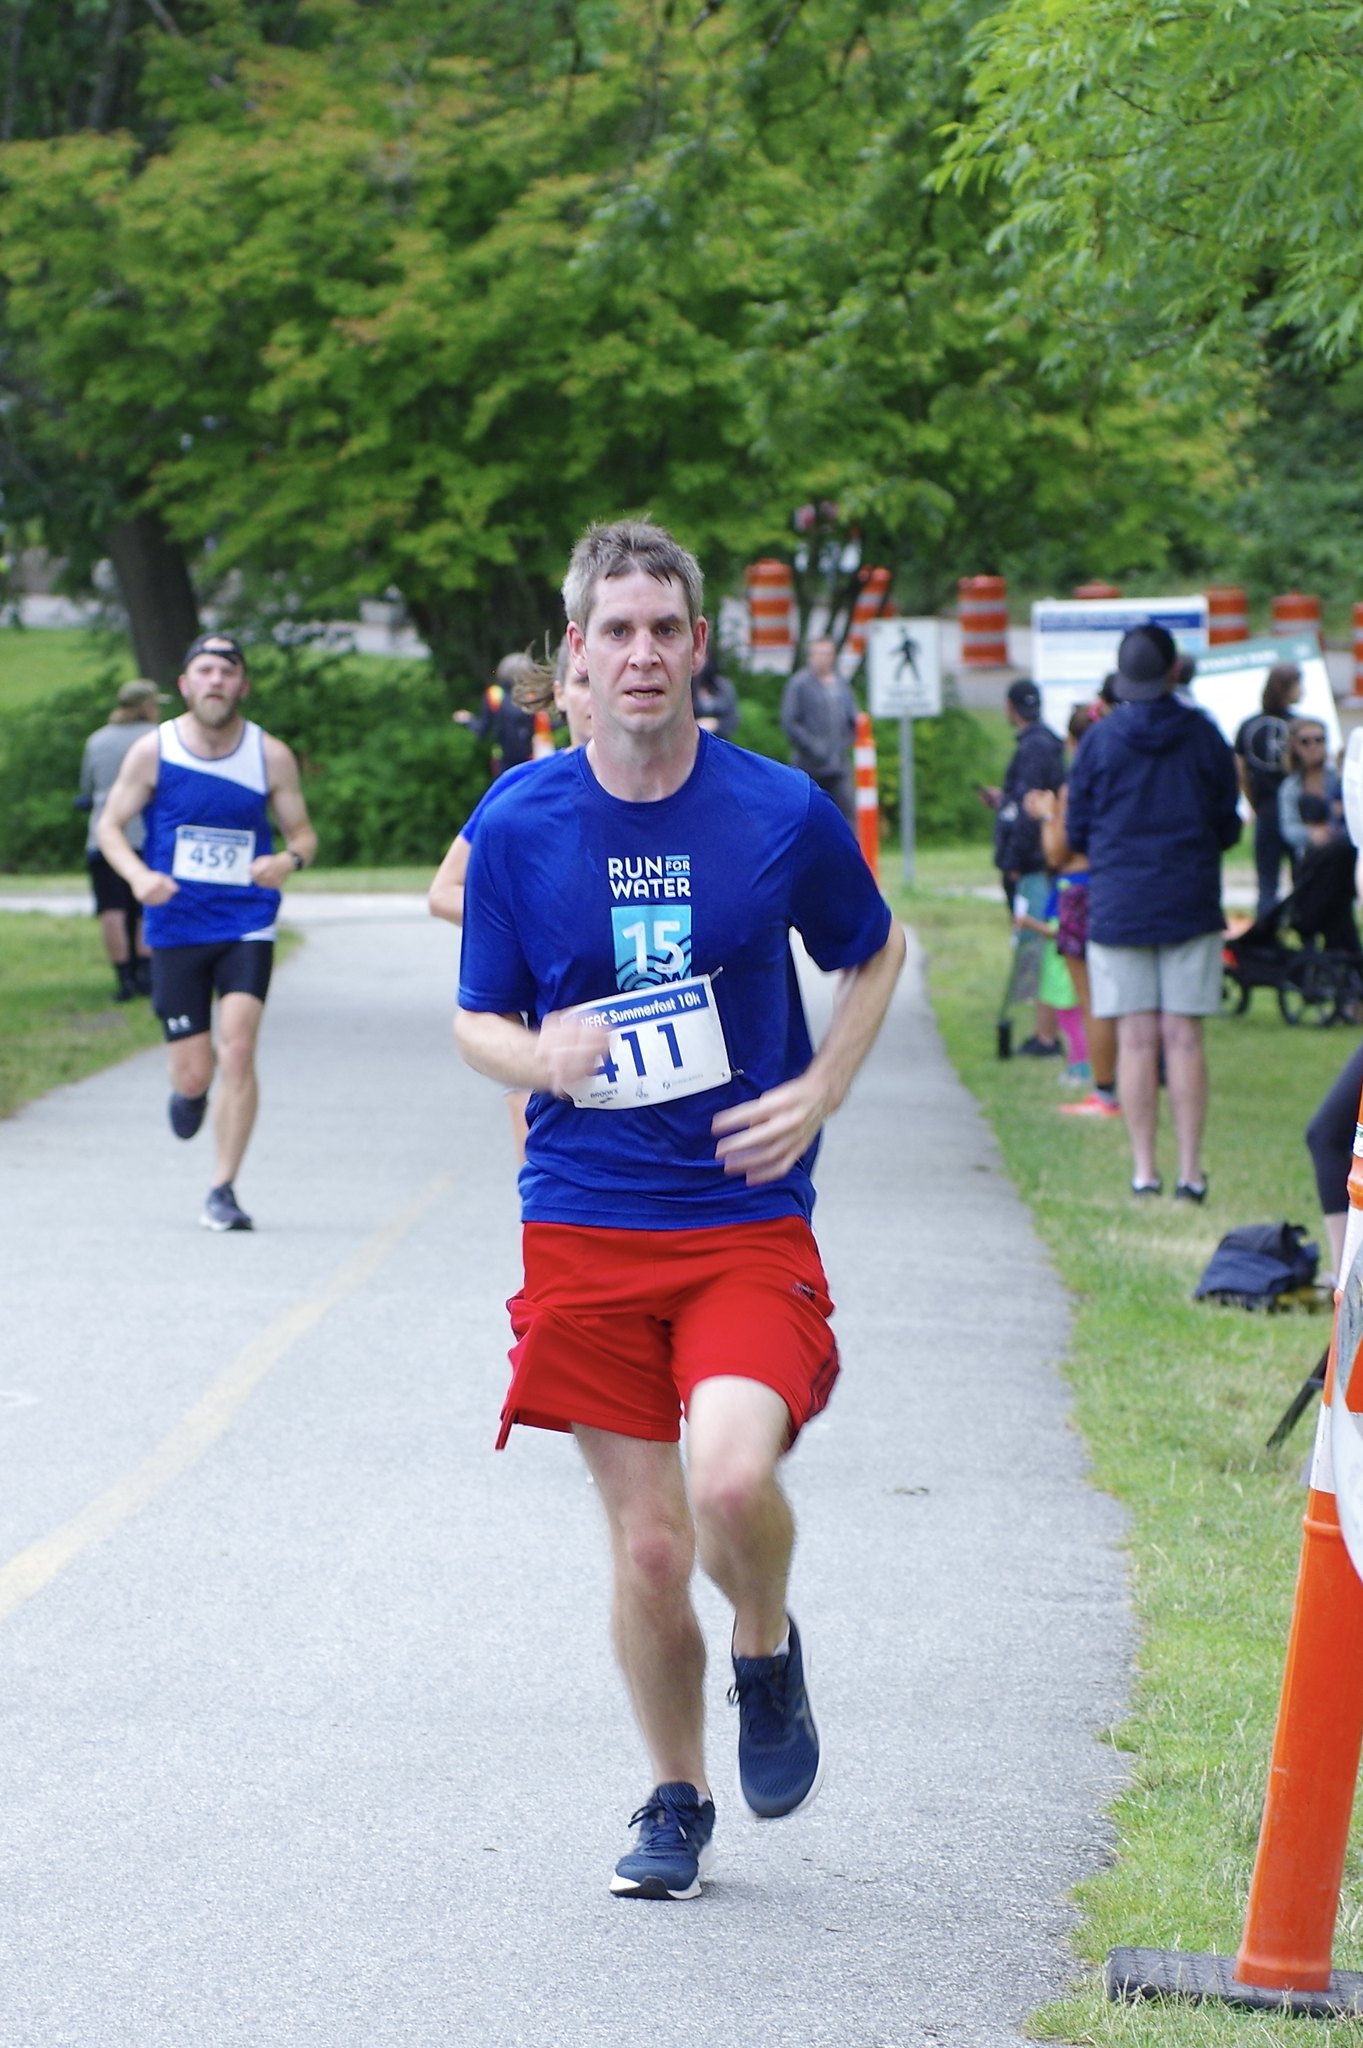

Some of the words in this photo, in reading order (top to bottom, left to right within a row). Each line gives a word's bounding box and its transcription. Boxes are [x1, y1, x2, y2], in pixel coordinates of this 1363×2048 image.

[190, 846, 237, 869] 459
[607, 855, 663, 879] RUN
[665, 860, 690, 872] FOR
[609, 877, 691, 900] WATER
[622, 920, 684, 974] 15
[610, 998, 676, 1024] Summerfast
